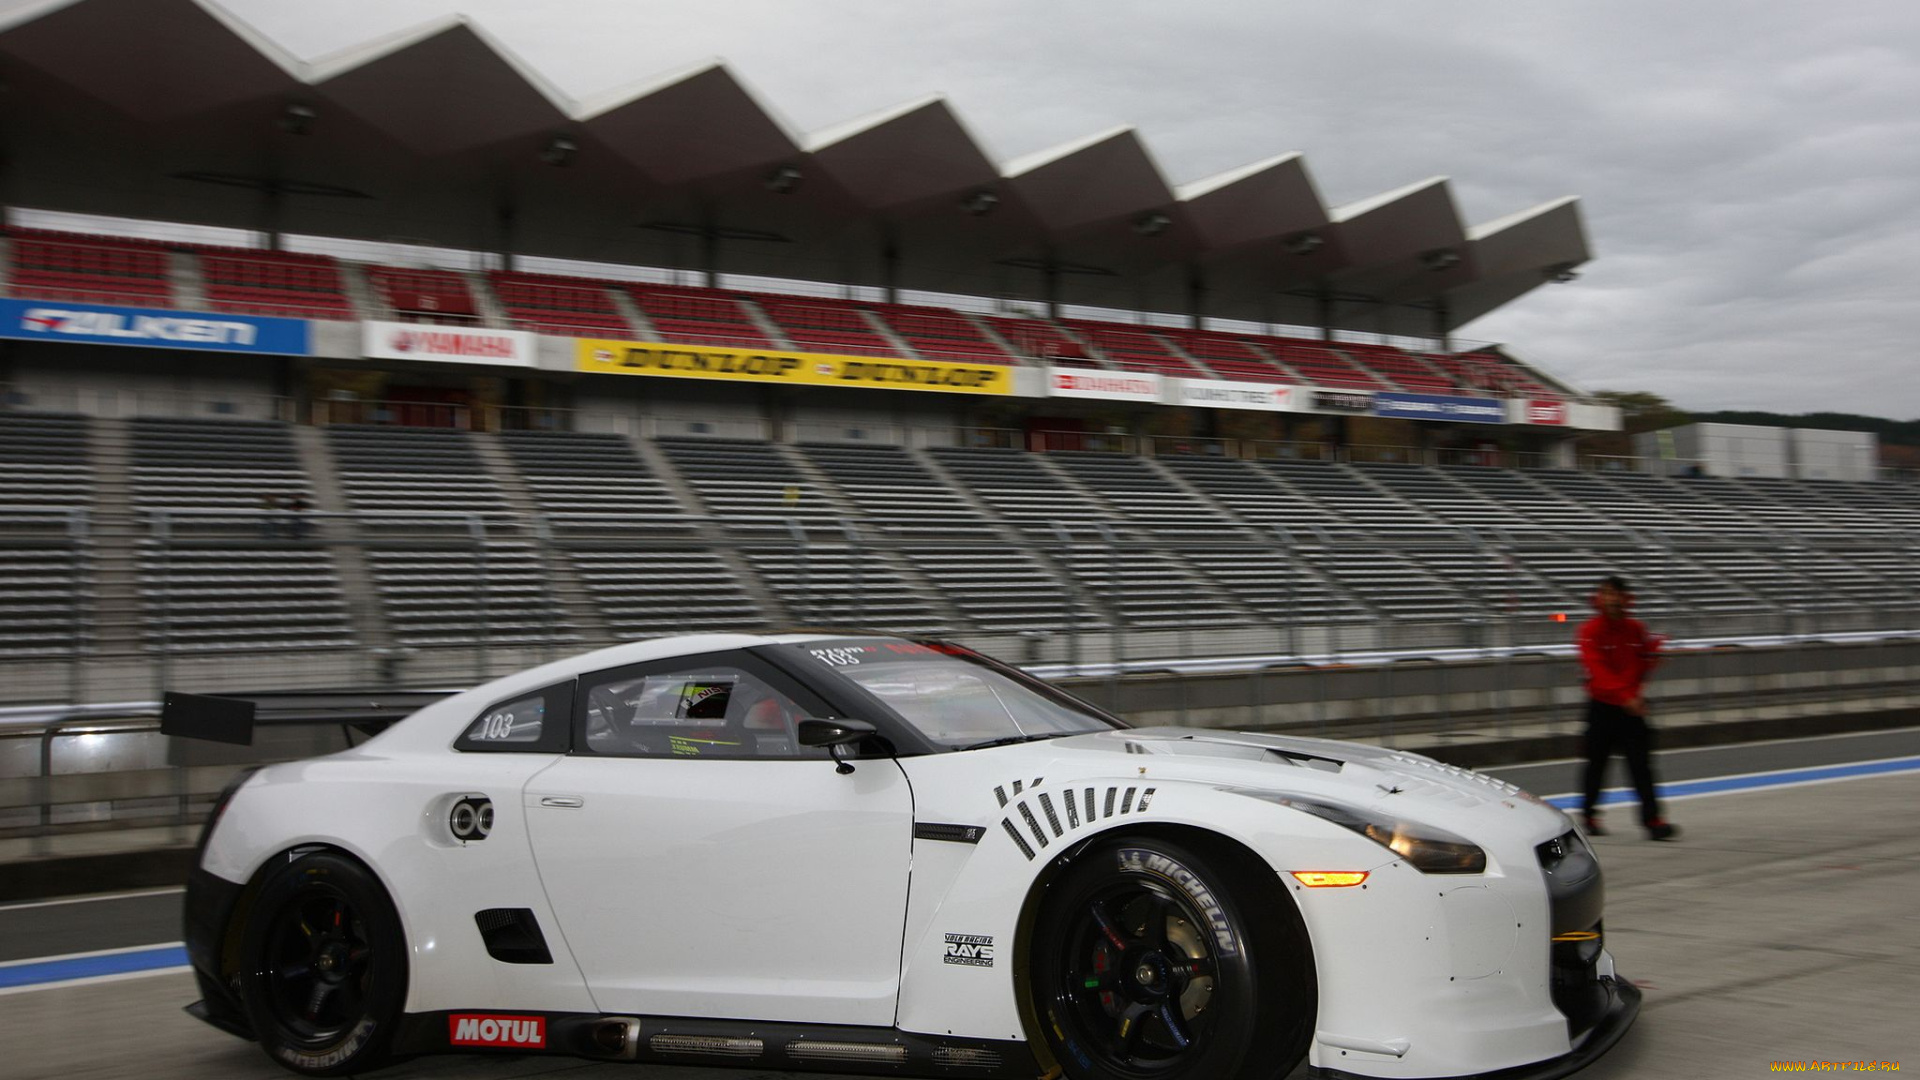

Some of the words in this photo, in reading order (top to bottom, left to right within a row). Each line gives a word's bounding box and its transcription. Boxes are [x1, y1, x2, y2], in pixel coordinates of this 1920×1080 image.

[416, 331, 518, 360] YAMAHA
[618, 347, 803, 376] DUNLOP
[836, 361, 998, 388] DUNLOP
[817, 651, 860, 667] 103
[483, 713, 514, 740] 103
[1145, 853, 1236, 952] MICHELIN
[944, 943, 993, 959] RAYS
[455, 1018, 542, 1043] MOTUL
